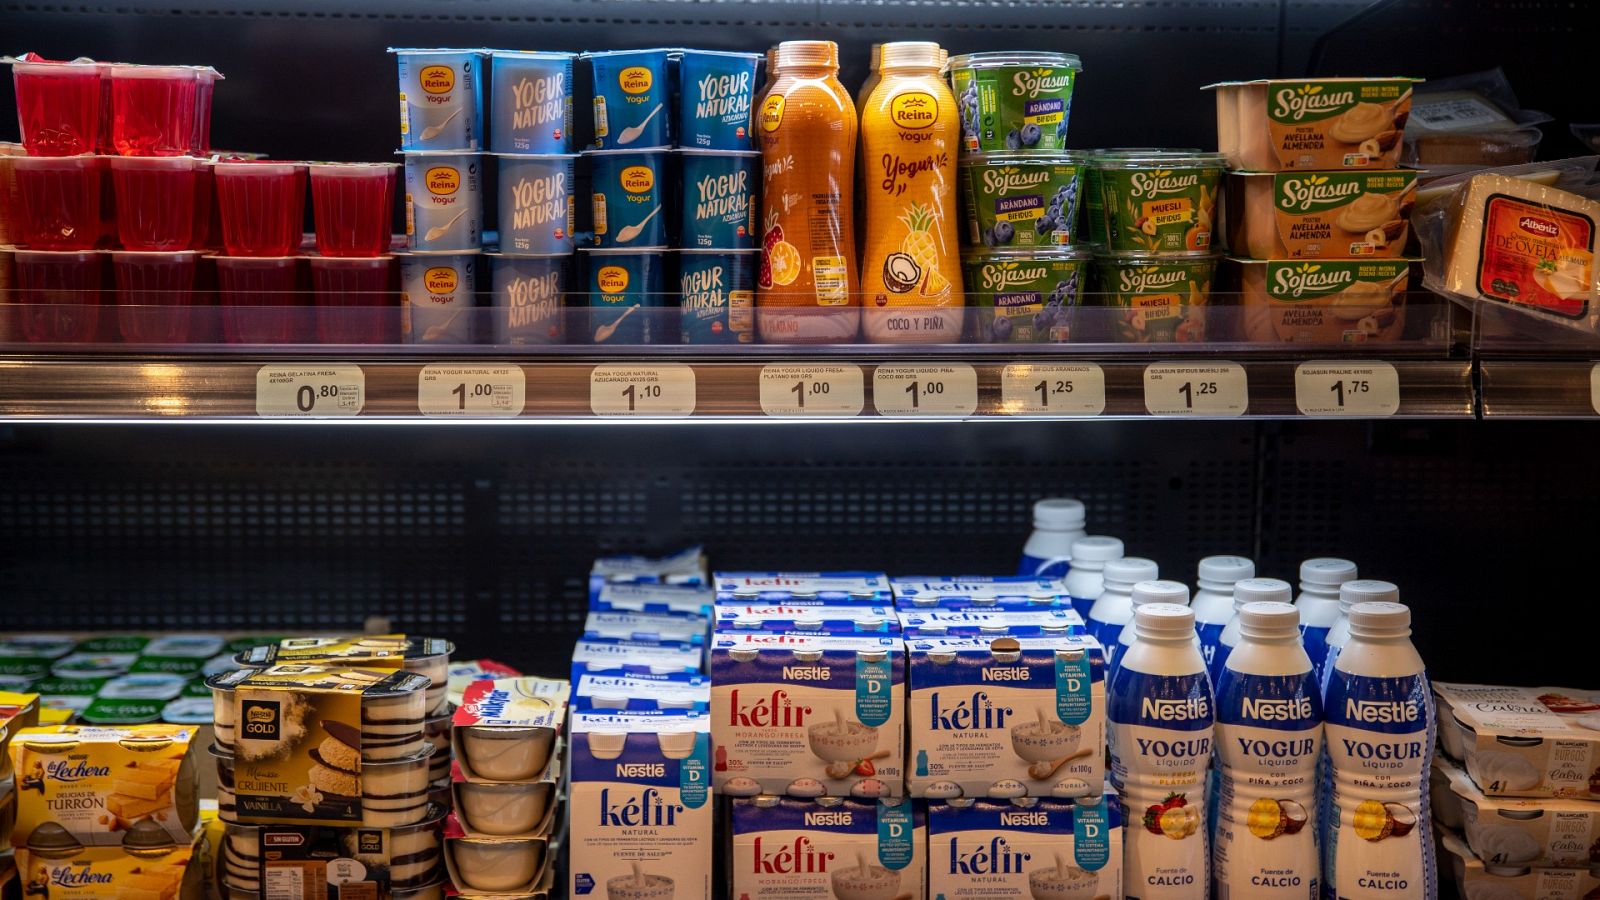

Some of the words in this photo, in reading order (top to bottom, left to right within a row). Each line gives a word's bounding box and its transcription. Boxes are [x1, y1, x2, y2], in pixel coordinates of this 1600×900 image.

[512, 72, 564, 110] YOGUR
[698, 71, 749, 101] YOGUR
[1012, 72, 1069, 98] Sojasun
[426, 95, 451, 104] Yogur
[626, 96, 650, 104] Yogur
[696, 94, 749, 118] NATURAL
[1274, 88, 1354, 120] Sojasun
[513, 99, 564, 130] NATURAL
[898, 110, 932, 120] Reina
[898, 132, 932, 143] Yogur
[1282, 142, 1324, 150] ALMENDRA
[882, 154, 936, 190] Yogur
[984, 169, 1050, 196] Sojasun
[512, 172, 564, 210] YOGUR
[697, 170, 747, 201] YOGUR
[1131, 172, 1198, 198] Sojasun
[1282, 180, 1360, 210] Sojasun
[432, 196, 456, 205] Yogur
[627, 195, 651, 204] Yogur
[696, 195, 748, 220] NATURAL
[1152, 202, 1182, 214] MUESLI
[513, 198, 566, 230] NATURAL
[1008, 211, 1033, 220] BIFIDUS
[1156, 214, 1181, 224] BIFIDUS
[1521, 218, 1558, 234] Albéniz
[1496, 234, 1513, 248] DE
[1516, 242, 1558, 260] OVEJA
[681, 266, 723, 297] YOGUR
[982, 265, 1047, 291] Sojasun
[1120, 268, 1186, 293] Sojasun
[1274, 267, 1351, 297] Sojasun
[430, 296, 454, 305] Yogur
[507, 272, 558, 308] YOGUR
[602, 294, 624, 303] Yogur
[508, 297, 558, 328] NATURAL
[681, 288, 726, 316] NATURAL
[1140, 298, 1170, 308] MUESLI
[888, 318, 910, 330] COCO
[914, 318, 920, 329] Y
[924, 316, 944, 330] PIÑA
[297, 385, 338, 412] 0,80
[452, 383, 492, 409] 1,00
[622, 385, 660, 410] 1,10
[792, 382, 830, 407] 1,00
[906, 382, 944, 407] 1,00
[1035, 380, 1073, 406] 1,25
[1179, 382, 1217, 408] 1,25
[1331, 381, 1369, 406] 1,75
[783, 666, 831, 680] Nestlé
[982, 667, 1031, 681] Nestlé
[868, 681, 881, 693] D
[728, 690, 812, 727] kéfir
[930, 692, 1013, 730] kéfir
[1142, 697, 1208, 721] Nestlé
[1242, 697, 1312, 721] Nestlé
[1346, 698, 1418, 723] Nestlé
[247, 724, 276, 734] GOLD
[1137, 738, 1209, 757] YOGUR
[1238, 738, 1314, 757] YOGUR
[1343, 739, 1421, 760] YOGUR
[1555, 750, 1585, 762] BURGOS
[52, 759, 109, 782] Lechera
[616, 764, 664, 777] Nestlé
[1156, 758, 1195, 766] LÍQUIDO
[689, 771, 700, 782] D
[1249, 777, 1270, 785] PIÑA
[1550, 769, 1584, 782] Cabra
[47, 796, 104, 810] TURRÓN
[244, 801, 281, 812] VAINILLA
[599, 788, 683, 826] kéfir
[804, 812, 852, 826] Nestlé
[1000, 812, 1048, 826] Nestlé
[1555, 821, 1586, 832] BURGOS
[890, 824, 902, 837] D
[753, 836, 834, 874] kéfir
[949, 836, 1031, 874] kéfir
[1552, 839, 1585, 851] Cabra
[54, 866, 113, 888] Lechera
[1148, 875, 1193, 885] CALCIO
[1252, 876, 1300, 886] CALCIO
[1358, 878, 1408, 889] CALCIO
